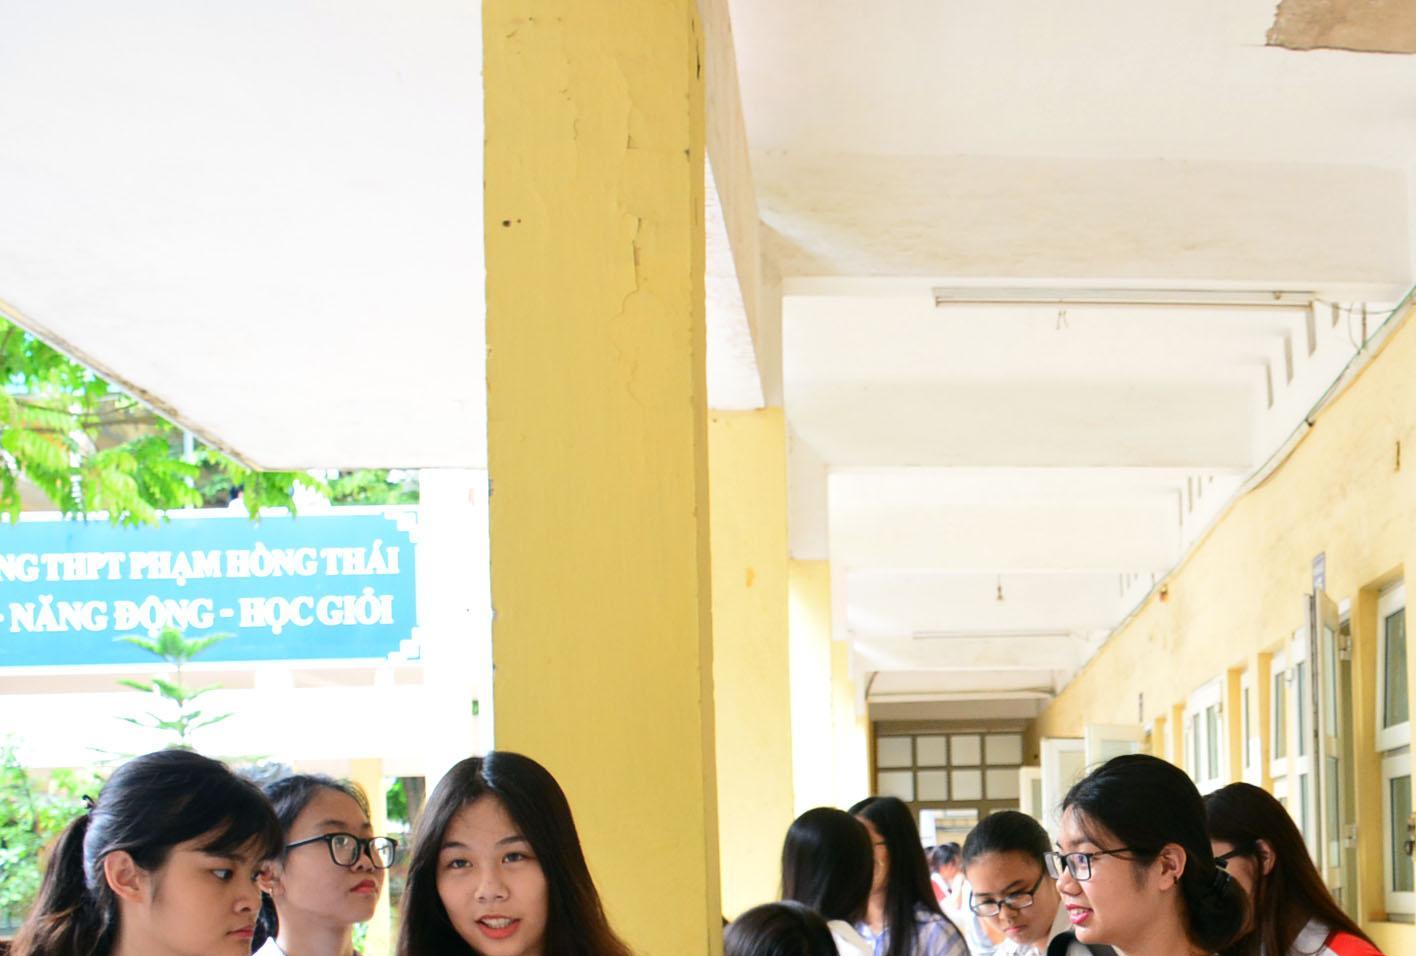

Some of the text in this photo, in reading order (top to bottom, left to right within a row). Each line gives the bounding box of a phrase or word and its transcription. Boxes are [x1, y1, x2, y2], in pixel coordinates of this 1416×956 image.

[40, 551, 126, 582] THPT
[130, 550, 222, 586] PHẠM
[320, 539, 400, 577] THÁI
[8, 594, 109, 633] NĂNG
[113, 595, 214, 637] ĐỘNG
[238, 596, 314, 635] HỌC
[316, 586, 394, 626] GIỎI
